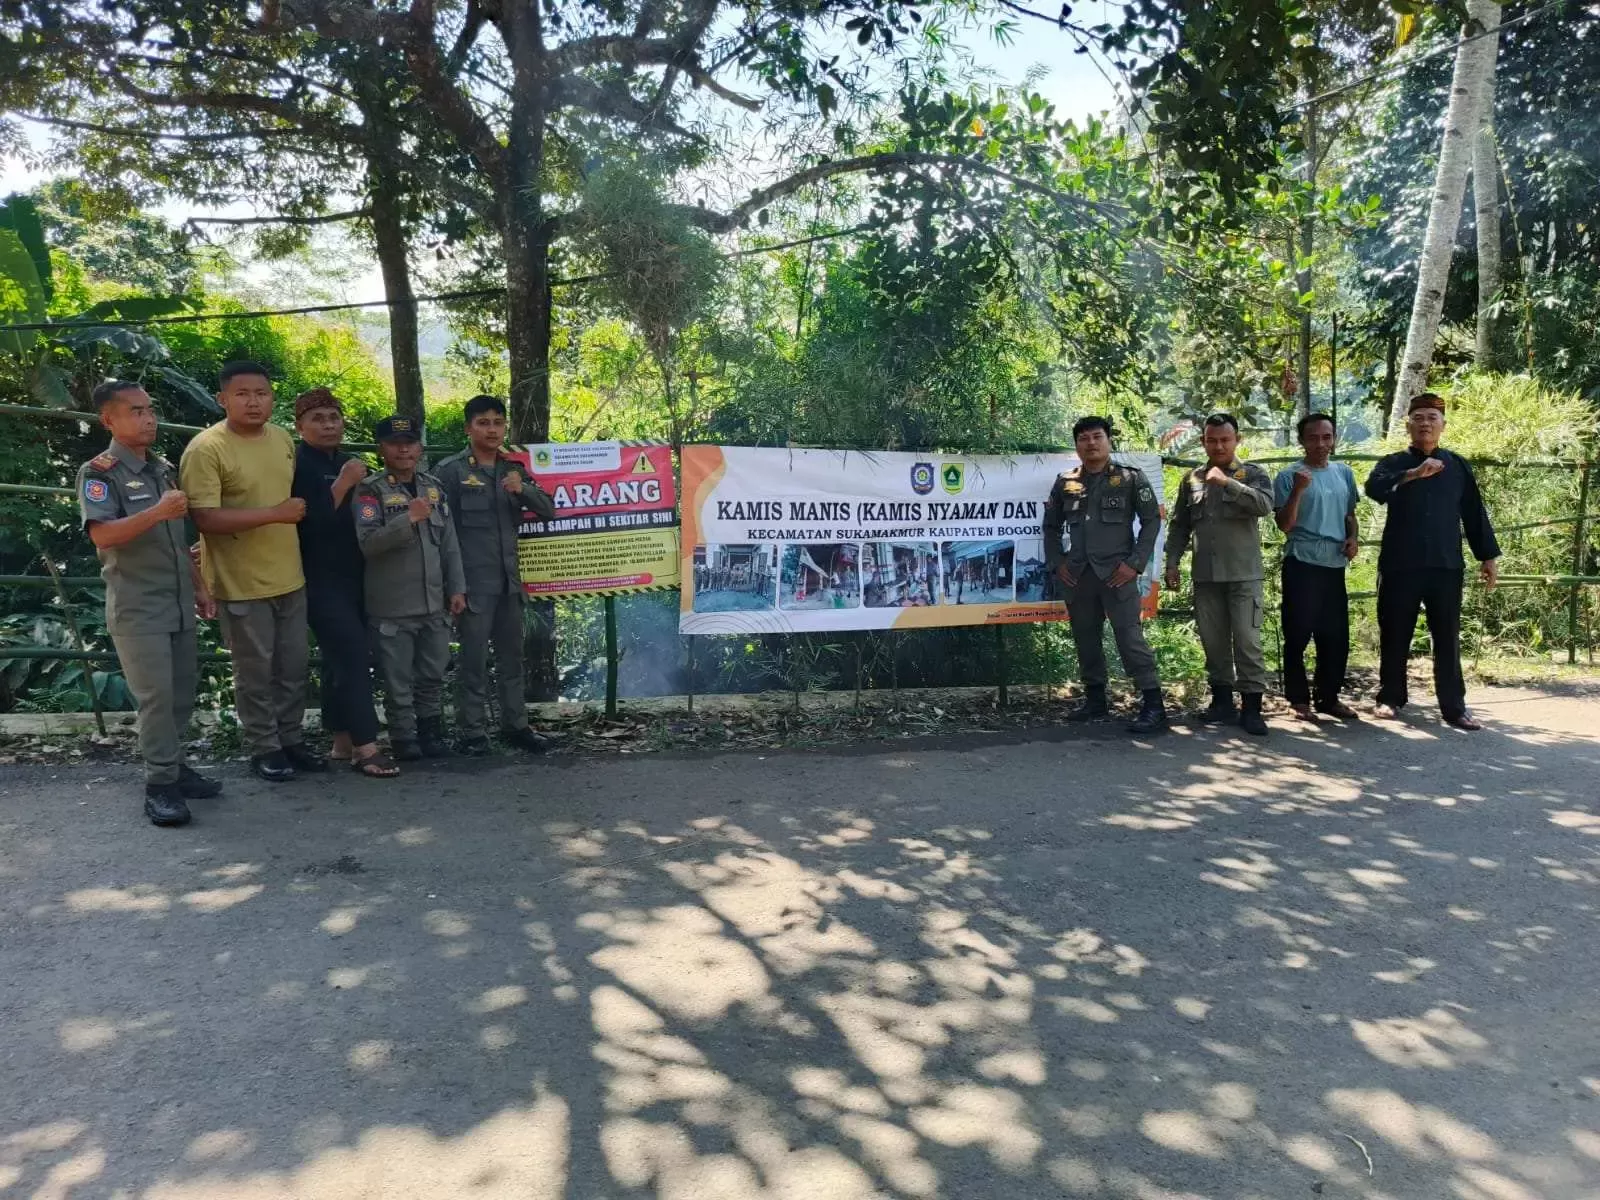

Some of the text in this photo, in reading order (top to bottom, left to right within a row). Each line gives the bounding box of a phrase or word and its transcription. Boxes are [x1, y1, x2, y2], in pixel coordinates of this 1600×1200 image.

[553, 479, 661, 509] ARANG
[548, 518, 592, 532] SAMPAH
[595, 517, 606, 528] DI
[609, 514, 649, 528] SEKITAR
[653, 511, 673, 523] SINI
[717, 501, 1037, 526] KAMIS MANIS (KAMIS NYAMAN DAN
[747, 525, 1041, 540] KECAMATAN SUKAMAKMUR KAUPATEN BOGOR
